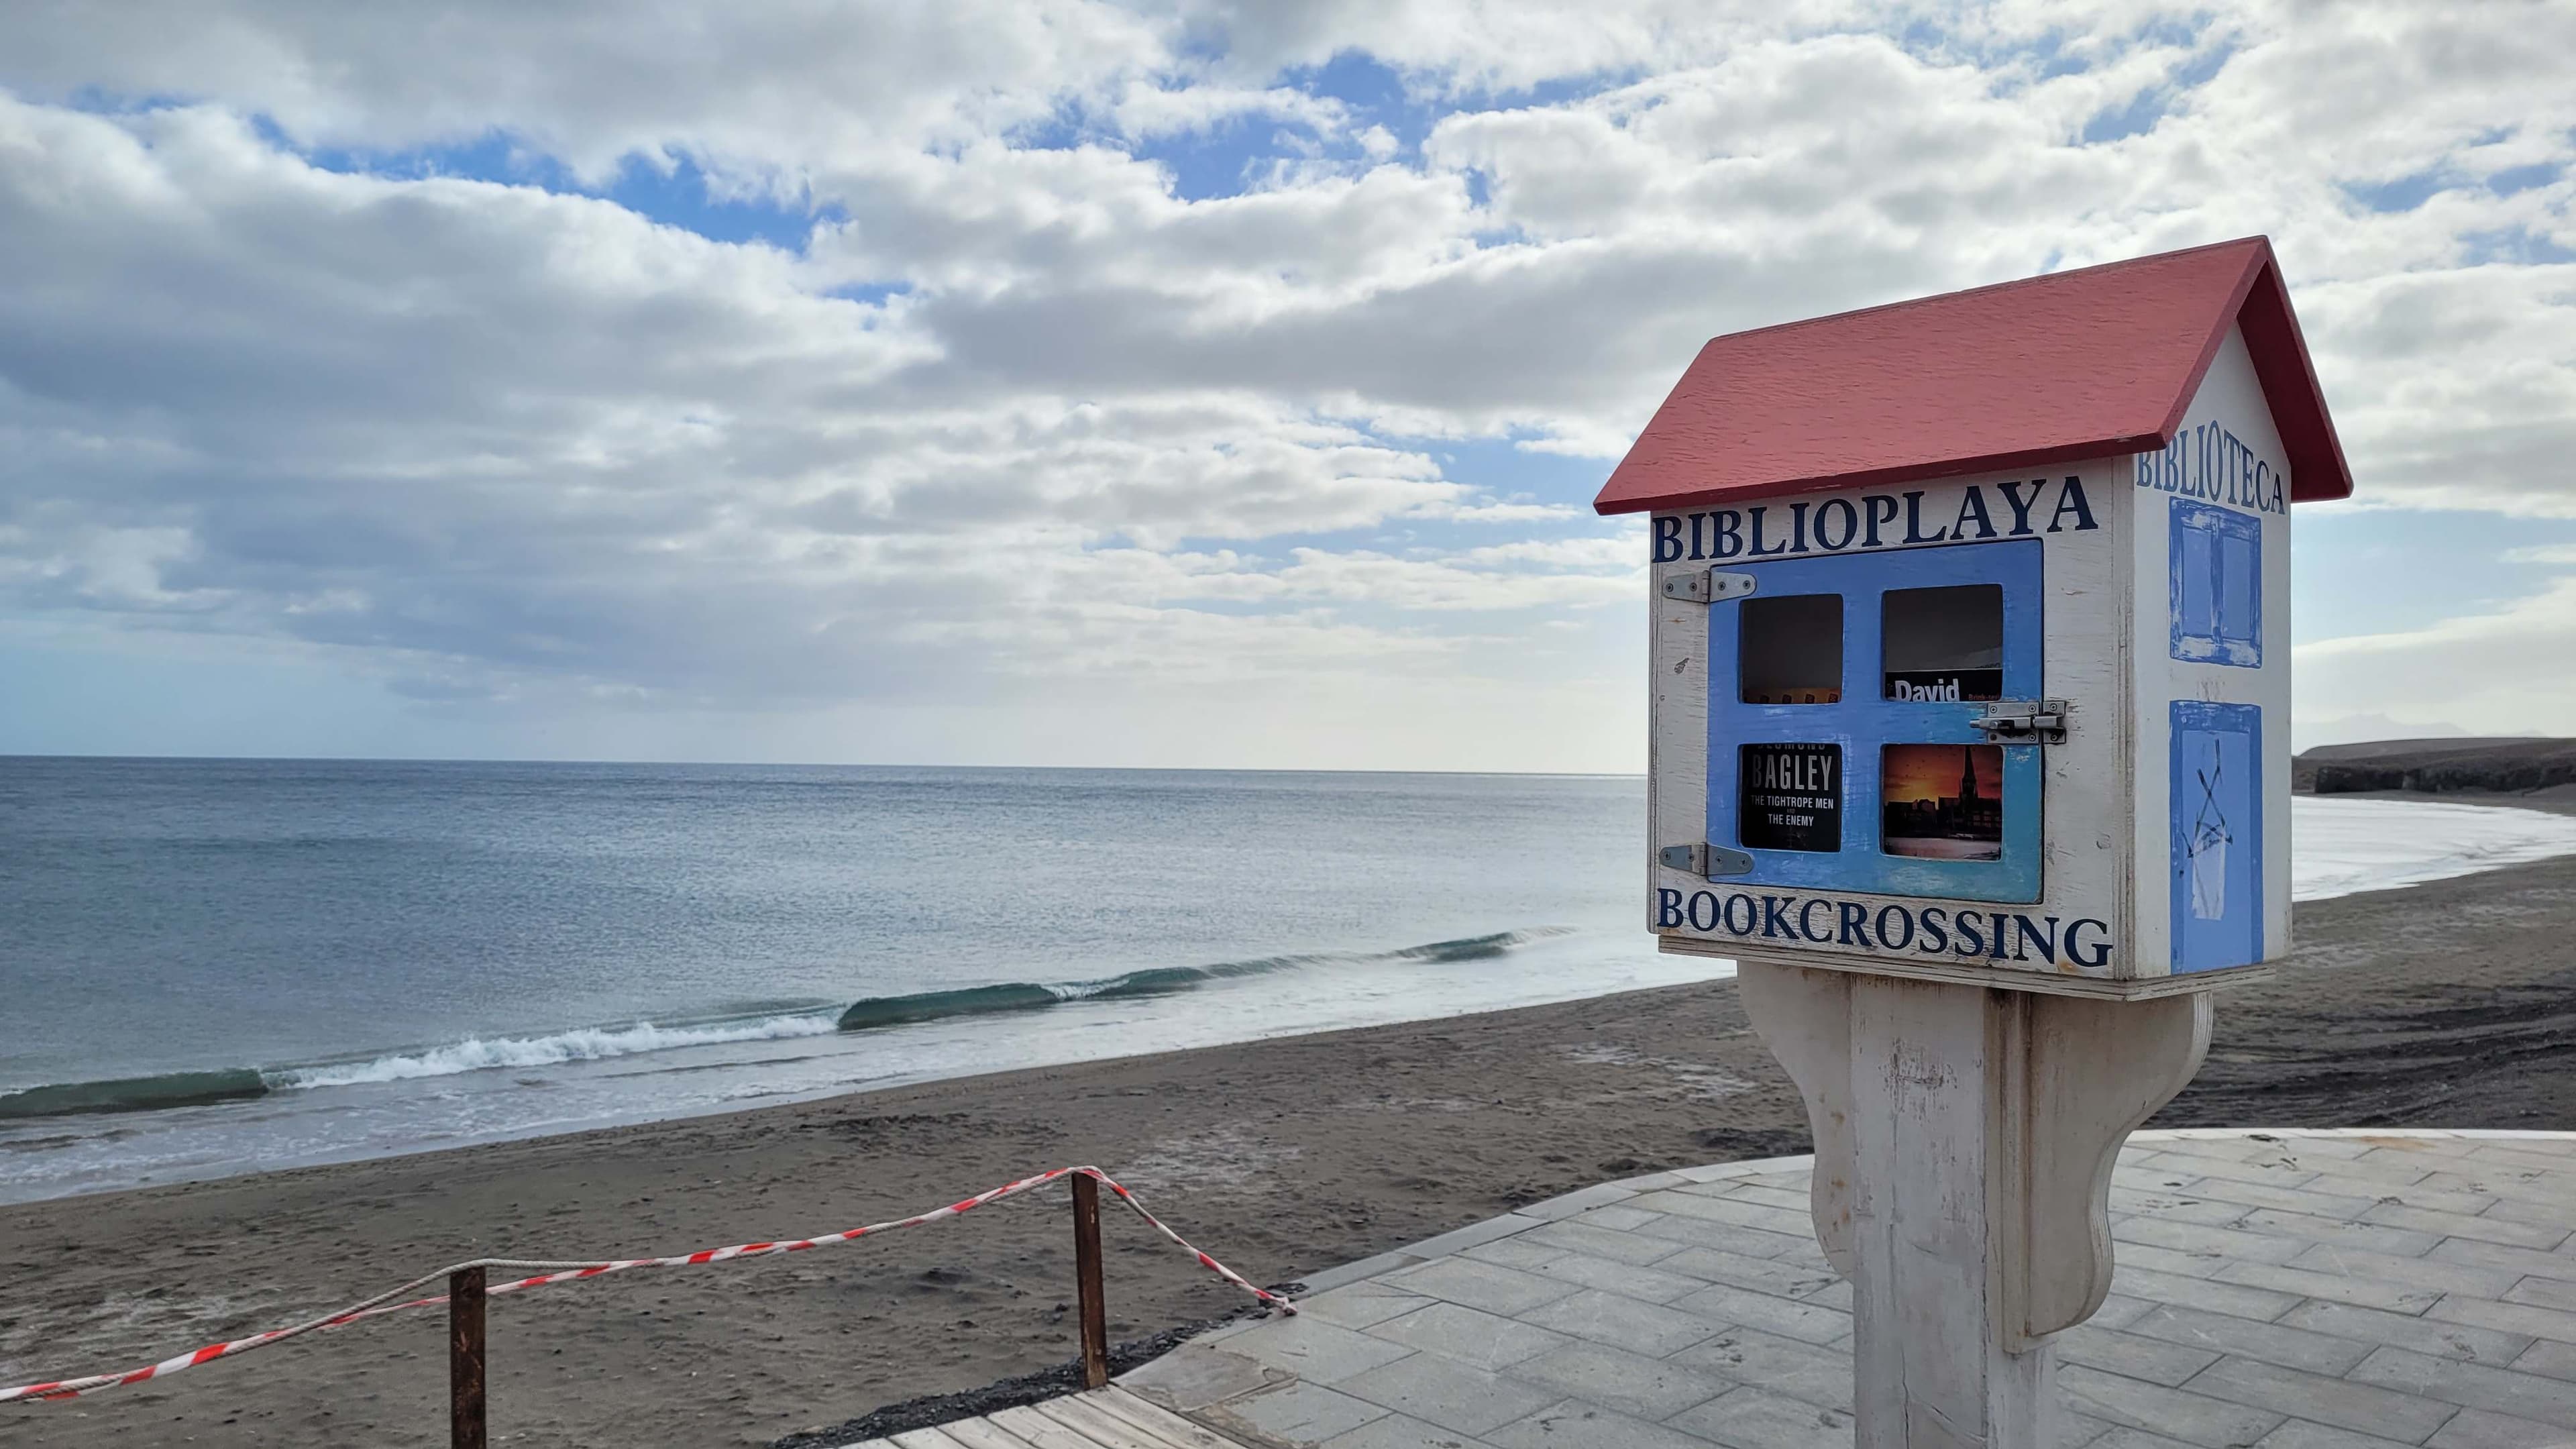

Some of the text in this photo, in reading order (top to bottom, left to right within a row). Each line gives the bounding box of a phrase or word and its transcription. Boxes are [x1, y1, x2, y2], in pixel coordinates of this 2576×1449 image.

[2137, 420, 2285, 515] BIBLIOTECA
[1651, 476, 2098, 564] BIBLIOPLAYA
[1895, 678, 1960, 702] David
[1752, 753, 1832, 791] BAGLEY
[1750, 795, 1833, 809] THE TIGHTROPE MEN
[1768, 814, 1814, 826] THE ENEMY
[1657, 888, 2113, 967] BOOKCROSSING
